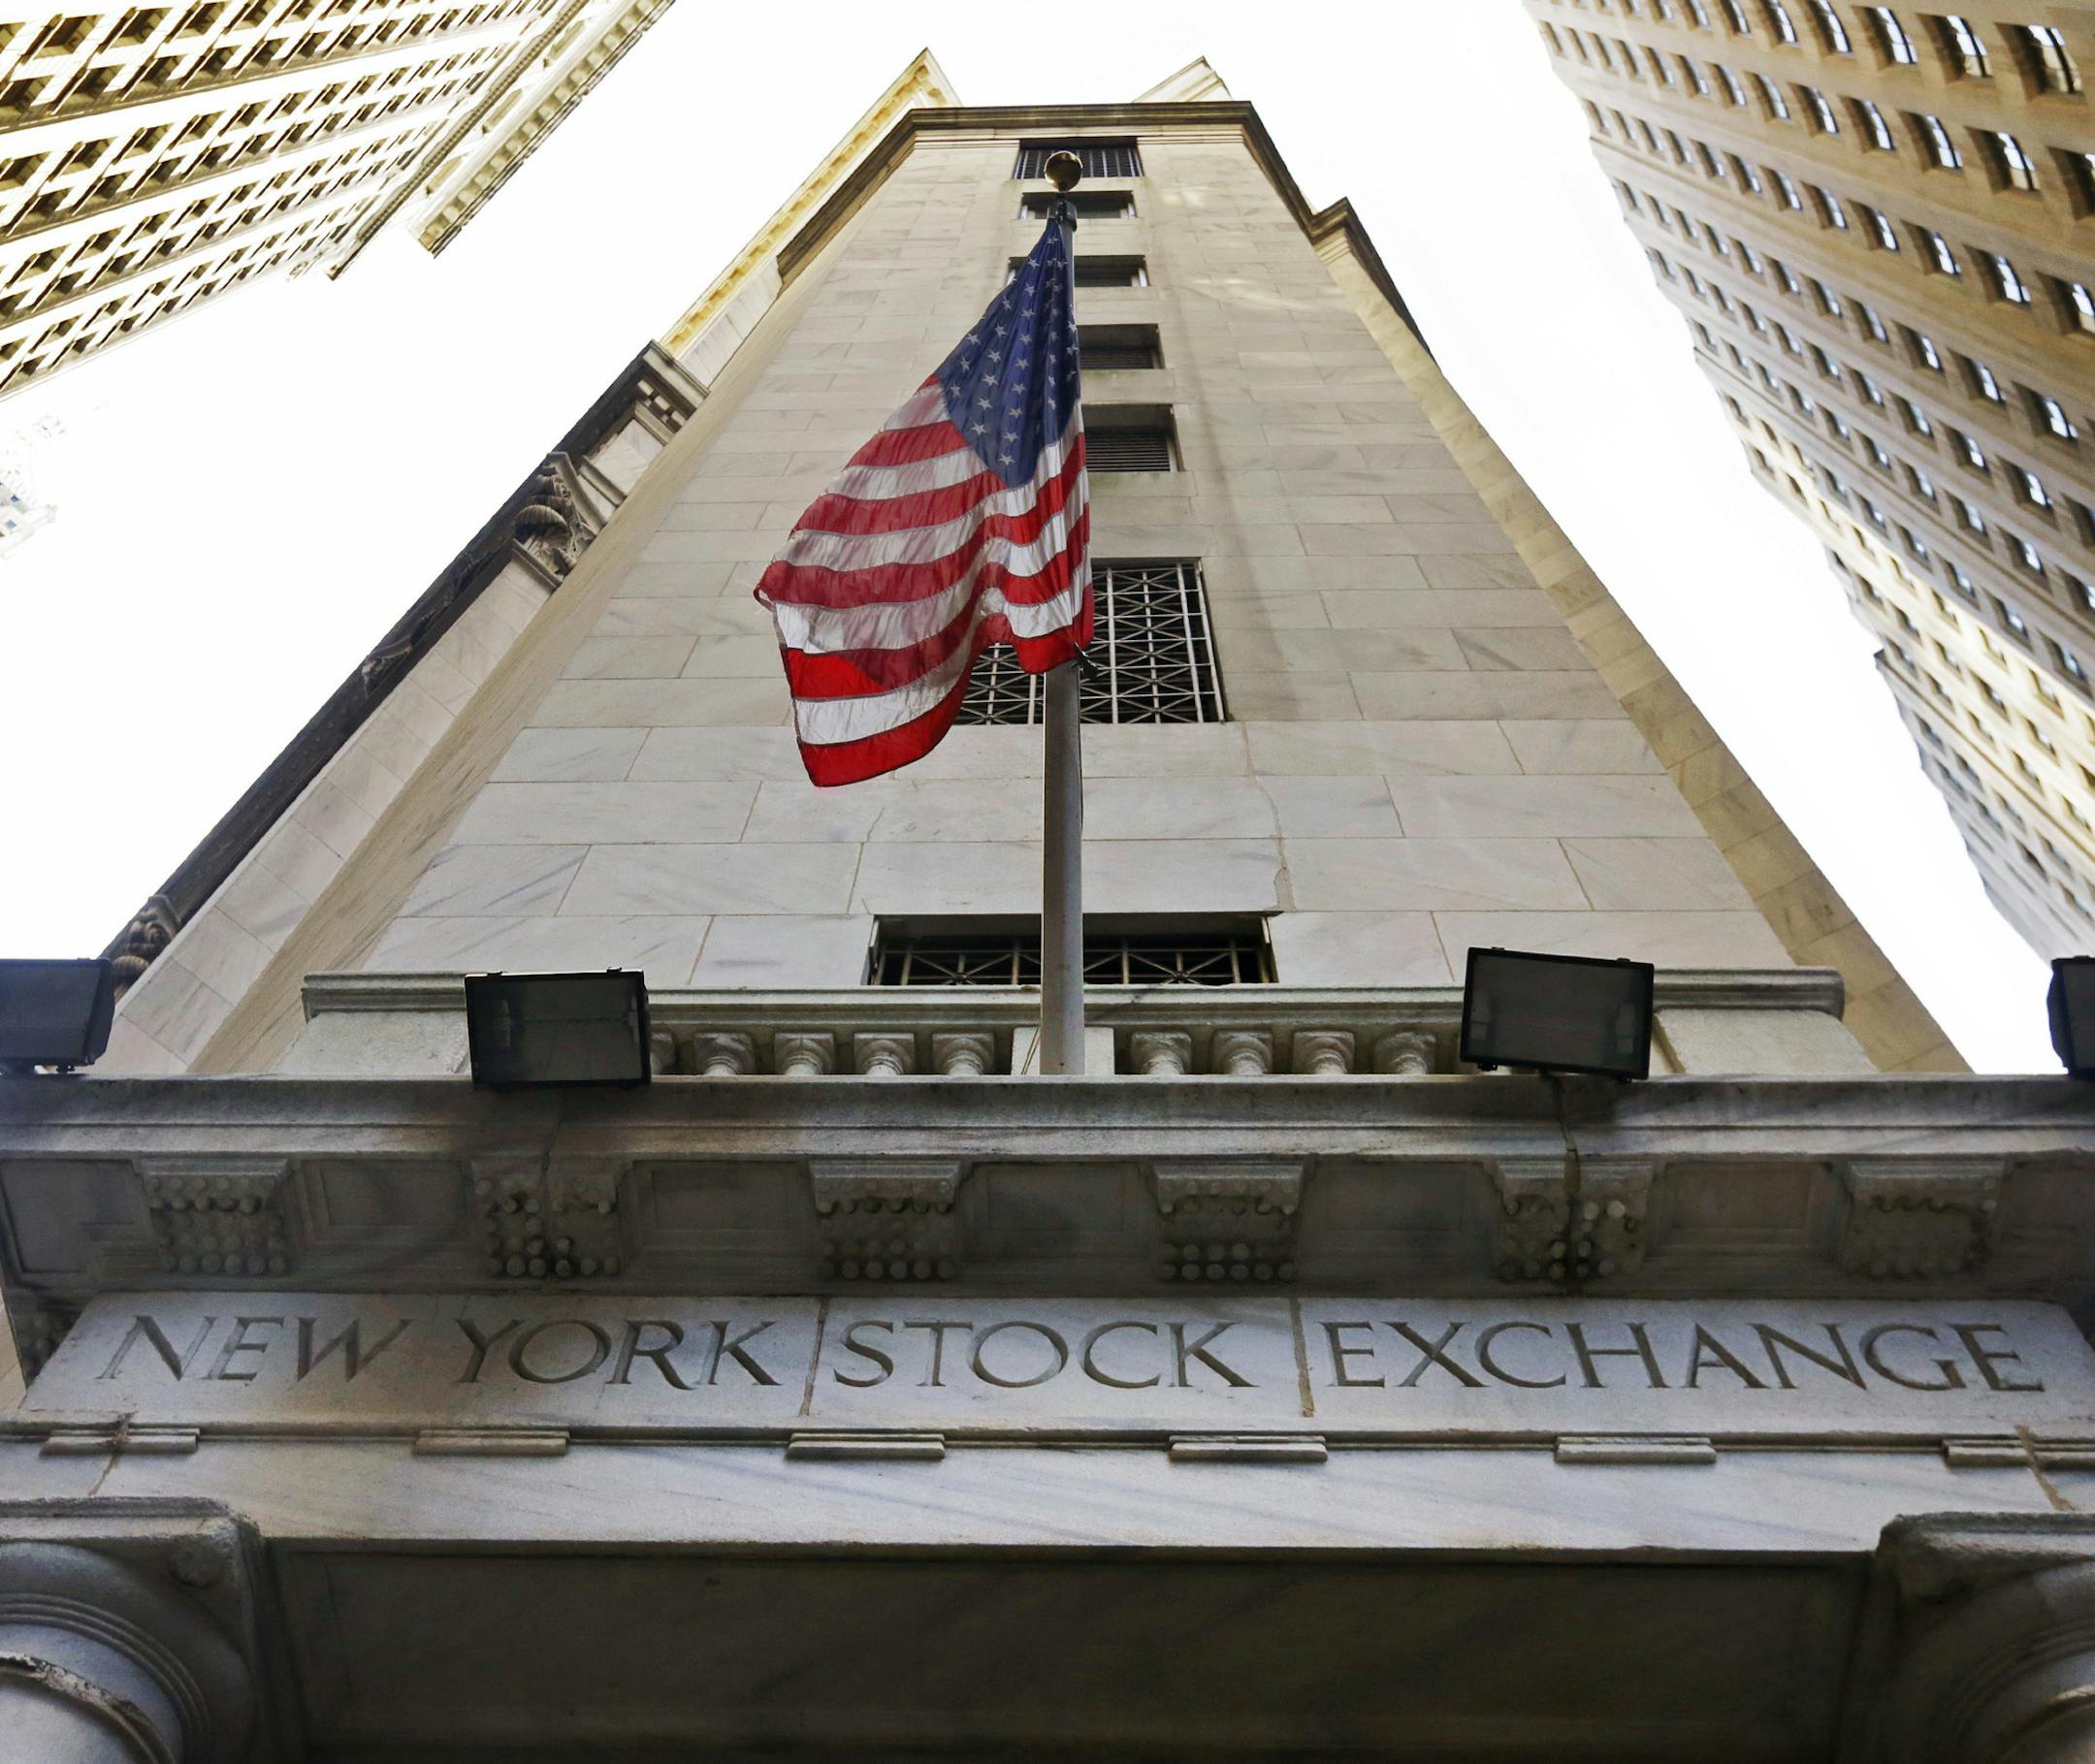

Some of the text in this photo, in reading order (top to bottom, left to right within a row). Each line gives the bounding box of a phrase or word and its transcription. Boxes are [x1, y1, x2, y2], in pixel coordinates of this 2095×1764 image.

[97, 1314, 2045, 1392] NEW YORK STOCK EXCHANGE
